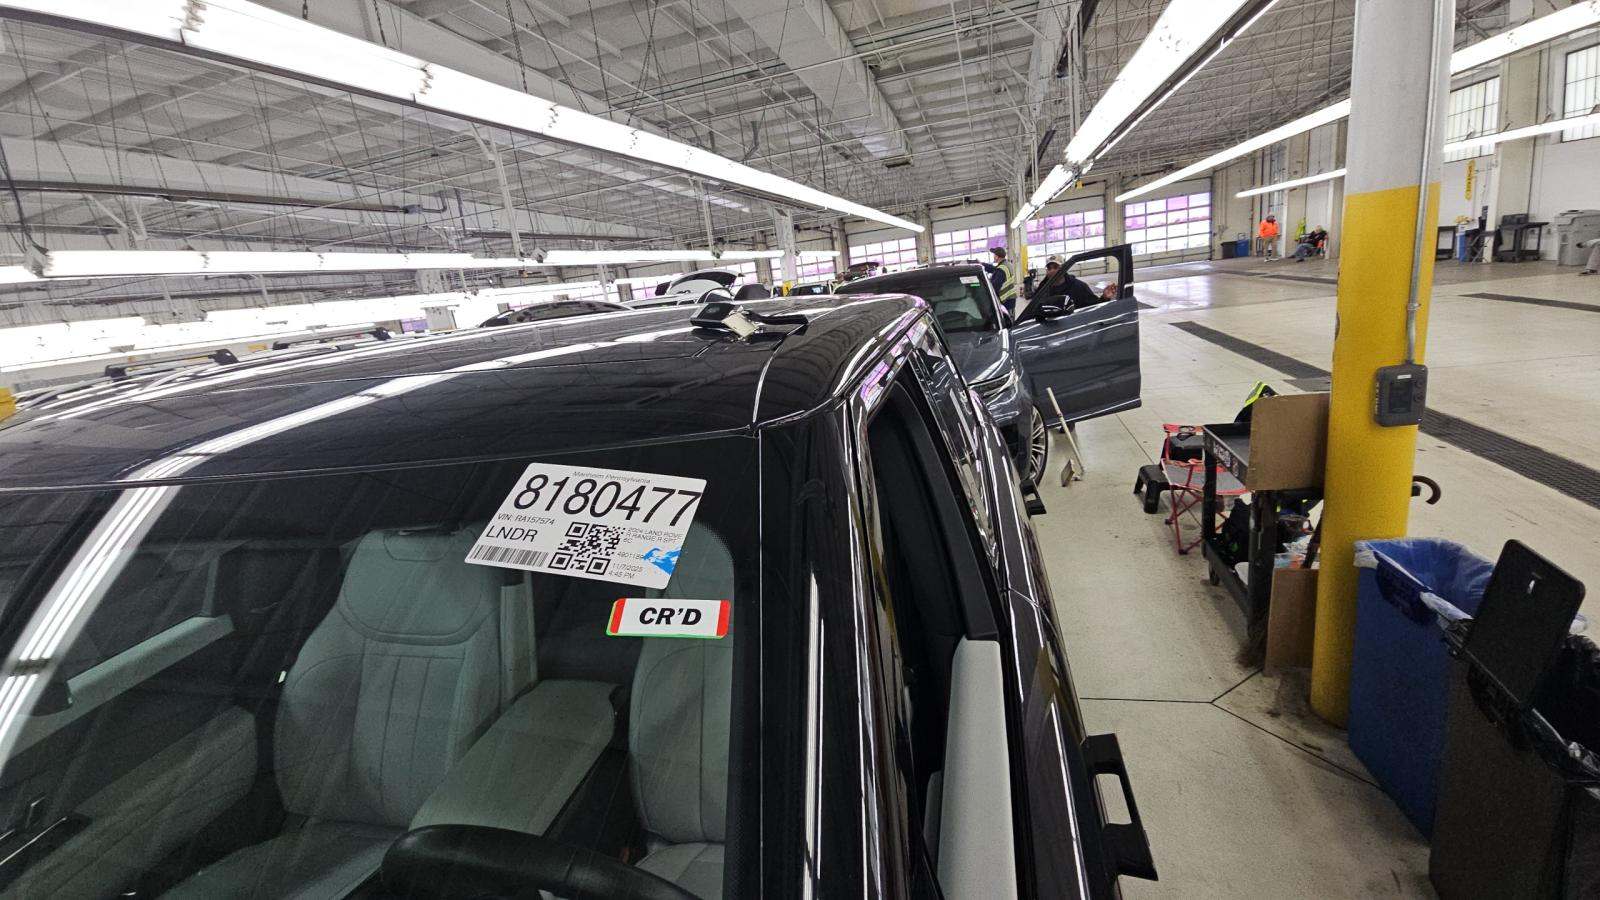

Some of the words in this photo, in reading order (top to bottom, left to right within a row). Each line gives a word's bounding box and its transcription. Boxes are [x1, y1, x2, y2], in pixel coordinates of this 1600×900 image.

[573, 471, 604, 479] Manheim
[514, 474, 702, 526] 8180477
[515, 515, 556, 525] RA157574
[486, 525, 538, 542] LNDR
[639, 607, 702, 625] CR'D
